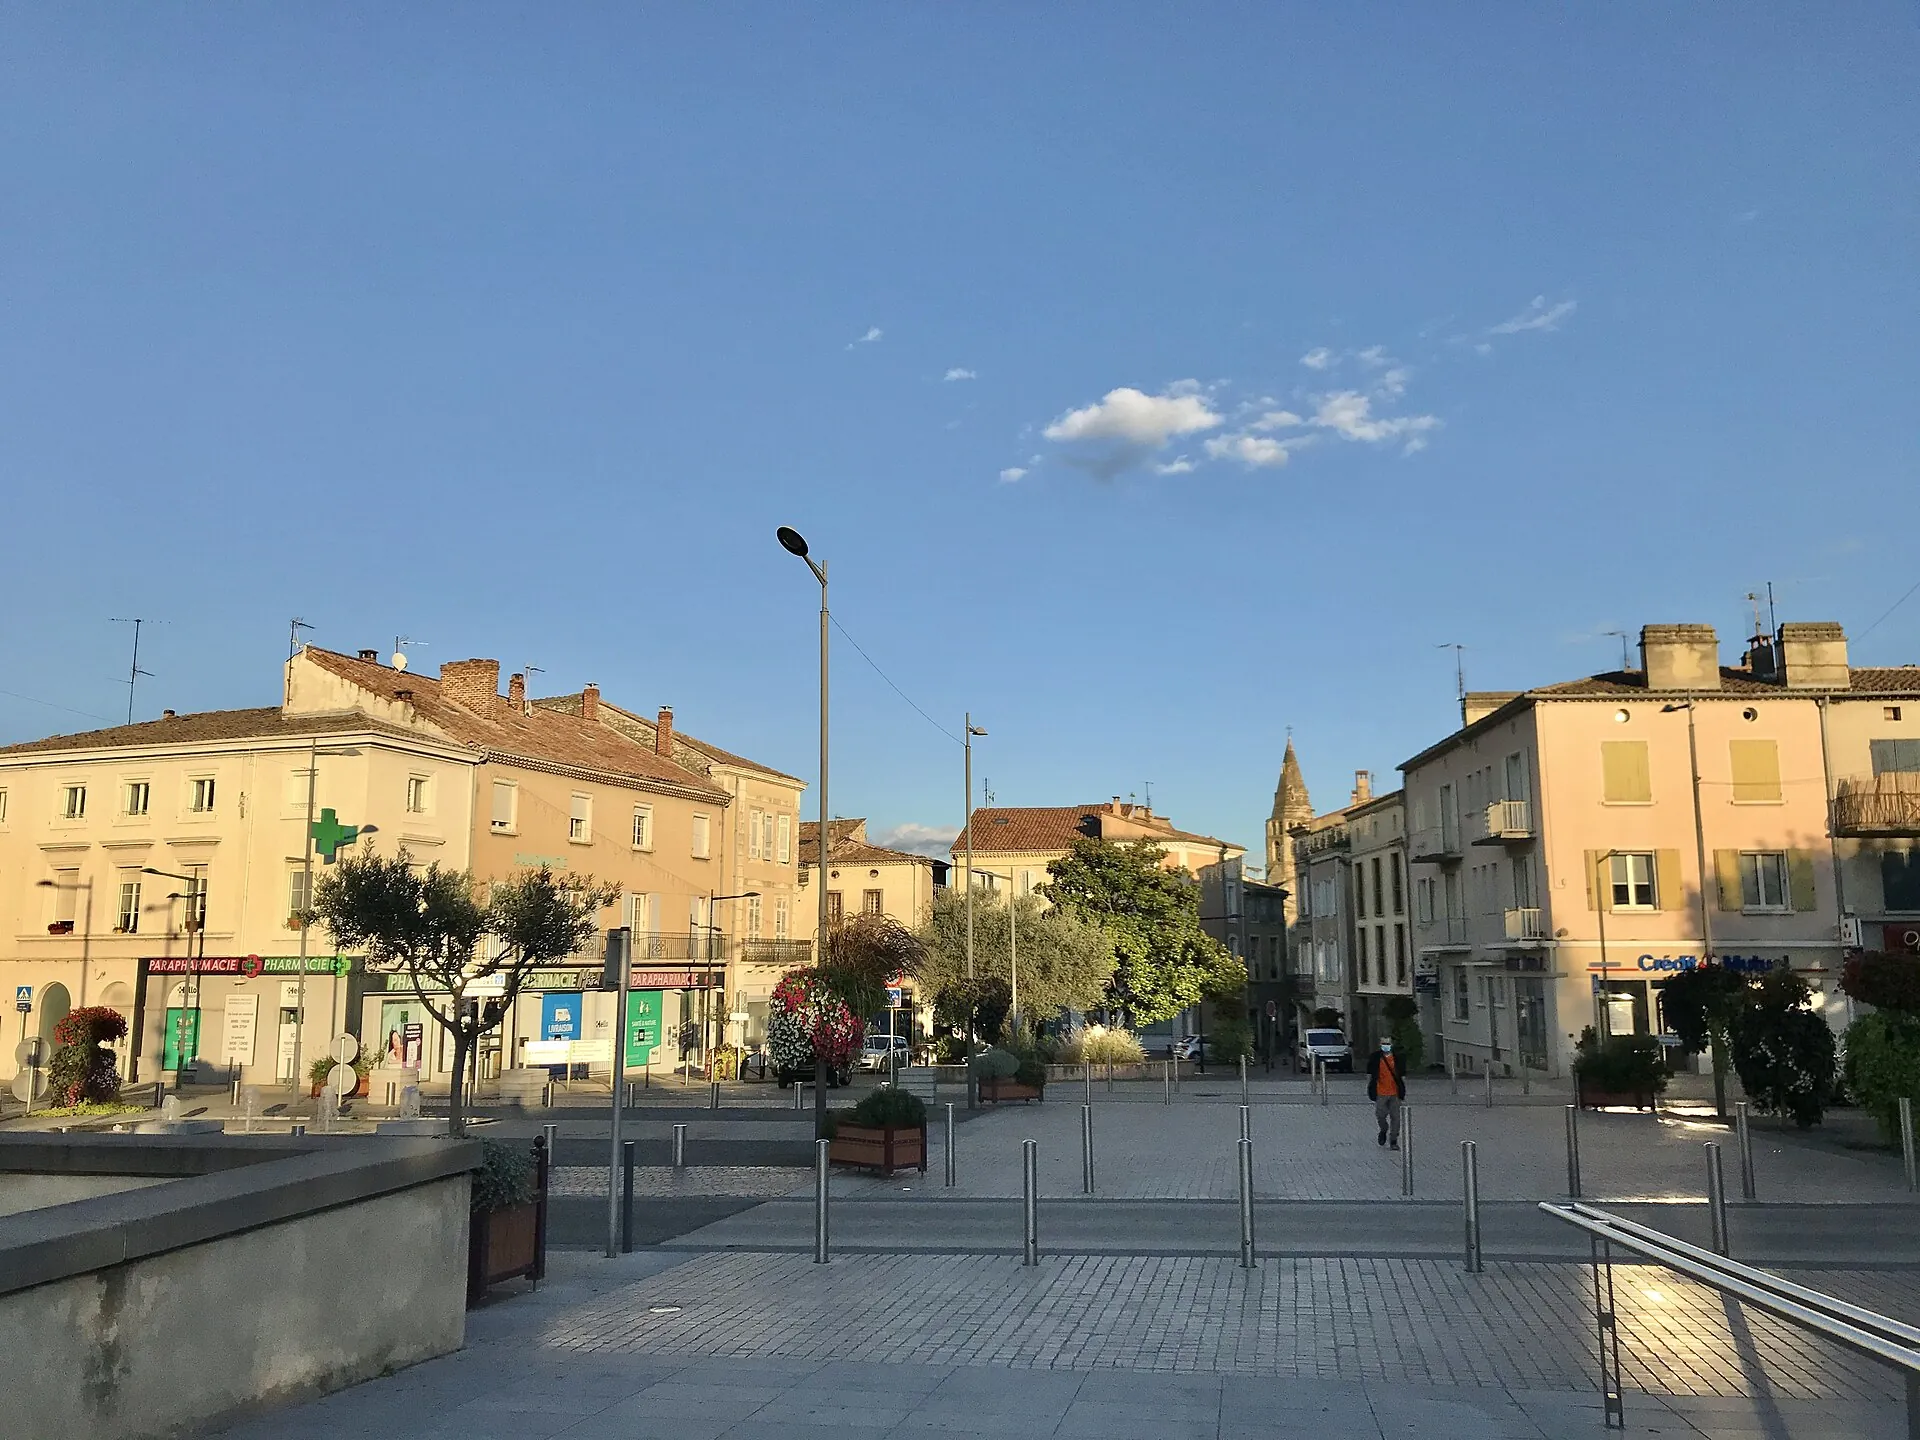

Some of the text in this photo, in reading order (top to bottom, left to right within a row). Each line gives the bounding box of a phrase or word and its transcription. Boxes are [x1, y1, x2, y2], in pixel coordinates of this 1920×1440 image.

[148, 959, 237, 971] PARAPHARMACIE
[263, 958, 328, 971] PHARMACIE
[1638, 954, 1696, 971] Crédit
[631, 973, 699, 986] PARAPHARMACIE
